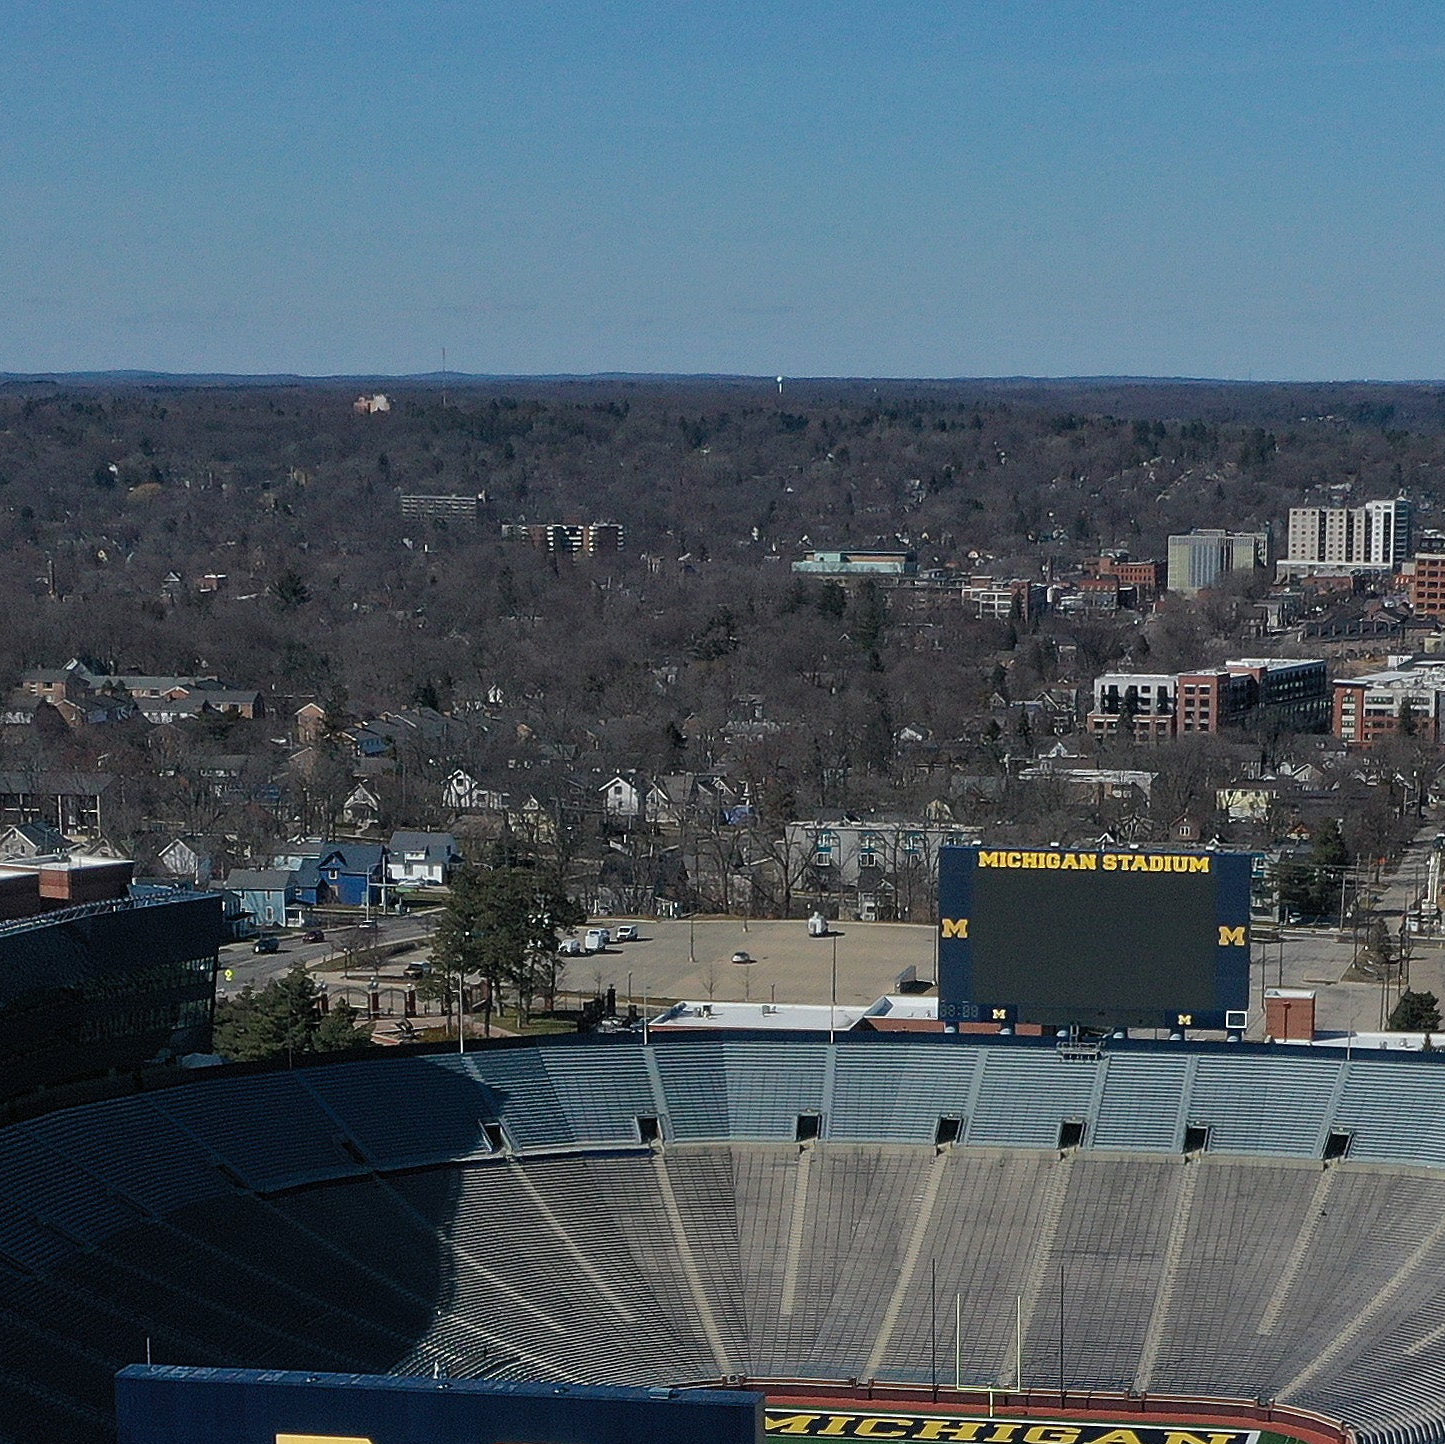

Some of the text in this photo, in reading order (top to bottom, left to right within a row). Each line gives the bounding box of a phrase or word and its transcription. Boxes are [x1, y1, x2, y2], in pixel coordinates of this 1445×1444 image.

[978, 851, 1210, 873] MICHIGAN STADIUM
[941, 919, 968, 939] M
[1218, 926, 1246, 946] M
[992, 1009, 1006, 1020] M
[1177, 1014, 1192, 1025] M
